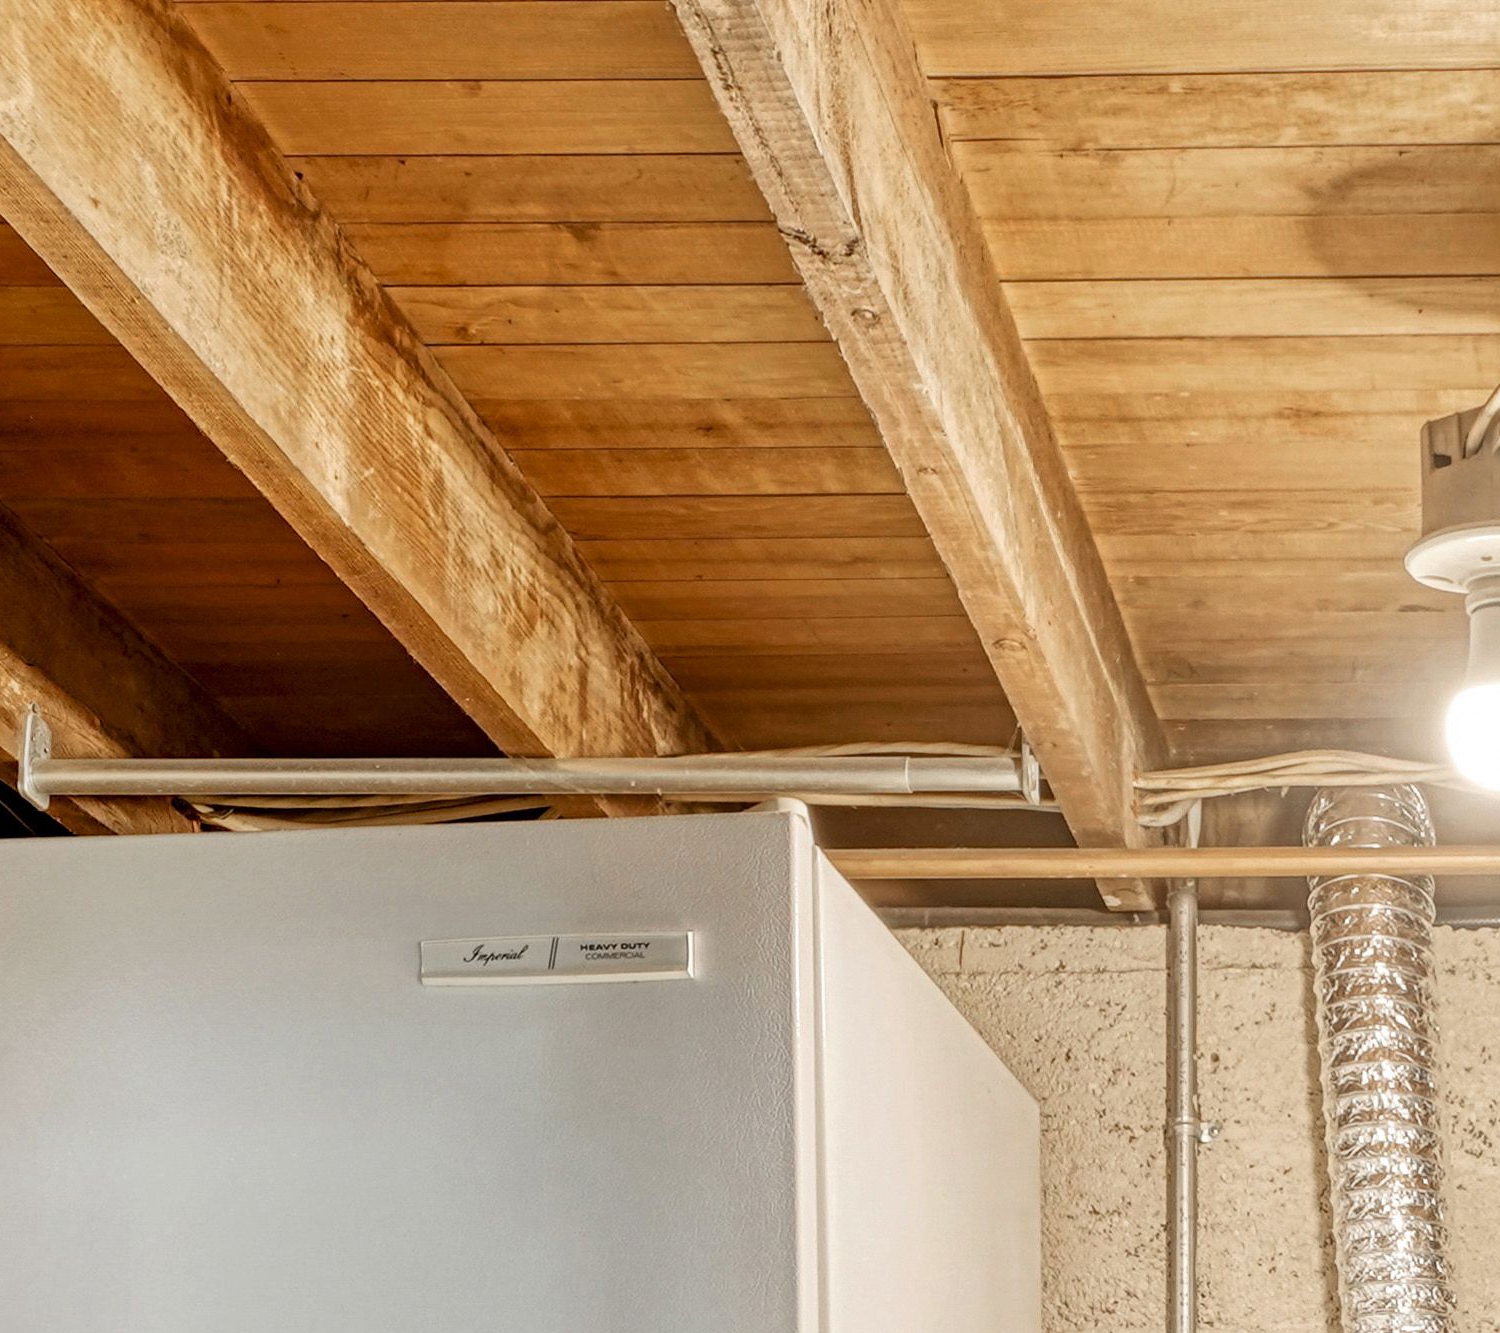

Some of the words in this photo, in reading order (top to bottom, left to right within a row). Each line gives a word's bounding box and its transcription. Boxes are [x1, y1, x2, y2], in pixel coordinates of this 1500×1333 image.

[580, 943, 617, 951] HEAVY
[620, 942, 650, 950] DUTY
[463, 944, 529, 966] Imperial
[585, 951, 645, 961] COMMERCIAL
